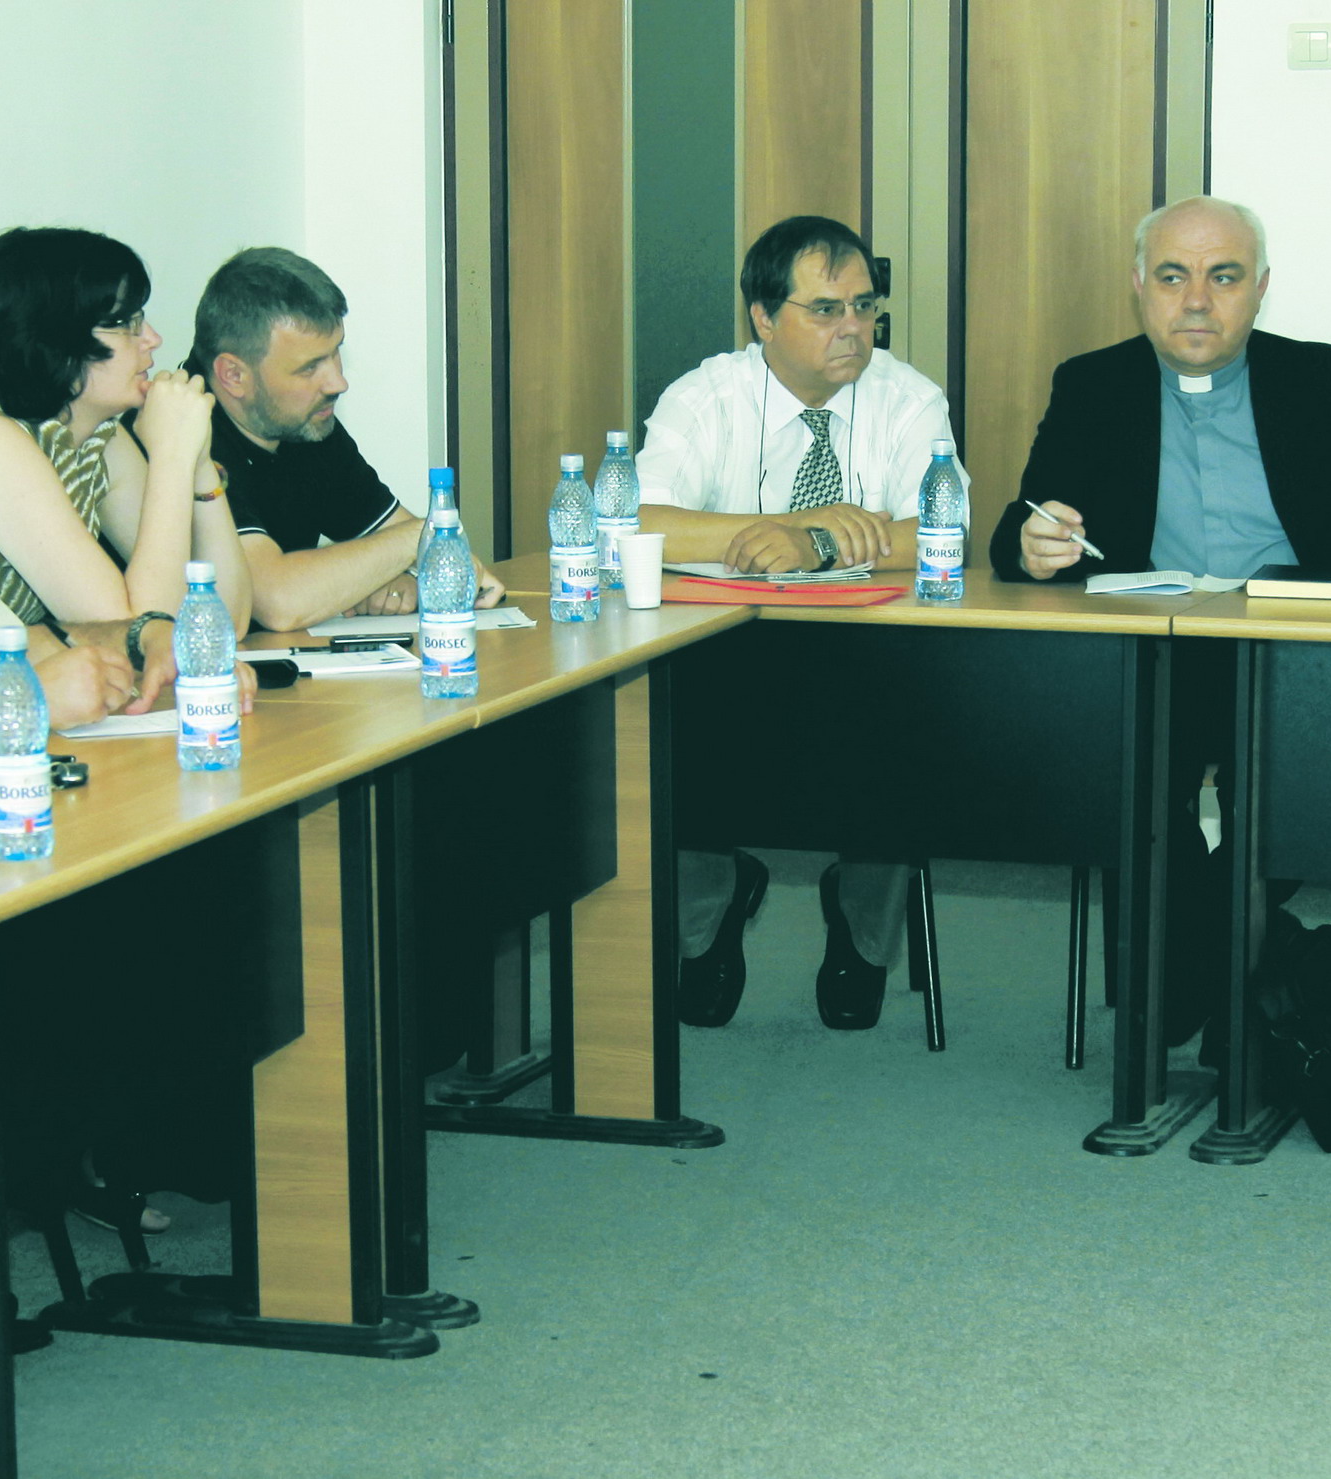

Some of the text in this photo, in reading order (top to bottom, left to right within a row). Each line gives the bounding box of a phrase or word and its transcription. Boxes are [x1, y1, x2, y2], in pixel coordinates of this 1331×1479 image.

[925, 547, 961, 558] BORSEC
[568, 567, 597, 578] BORSE
[424, 636, 467, 649] BORSEC
[186, 703, 233, 717] BORSEC
[0, 784, 49, 800] BORSEC
